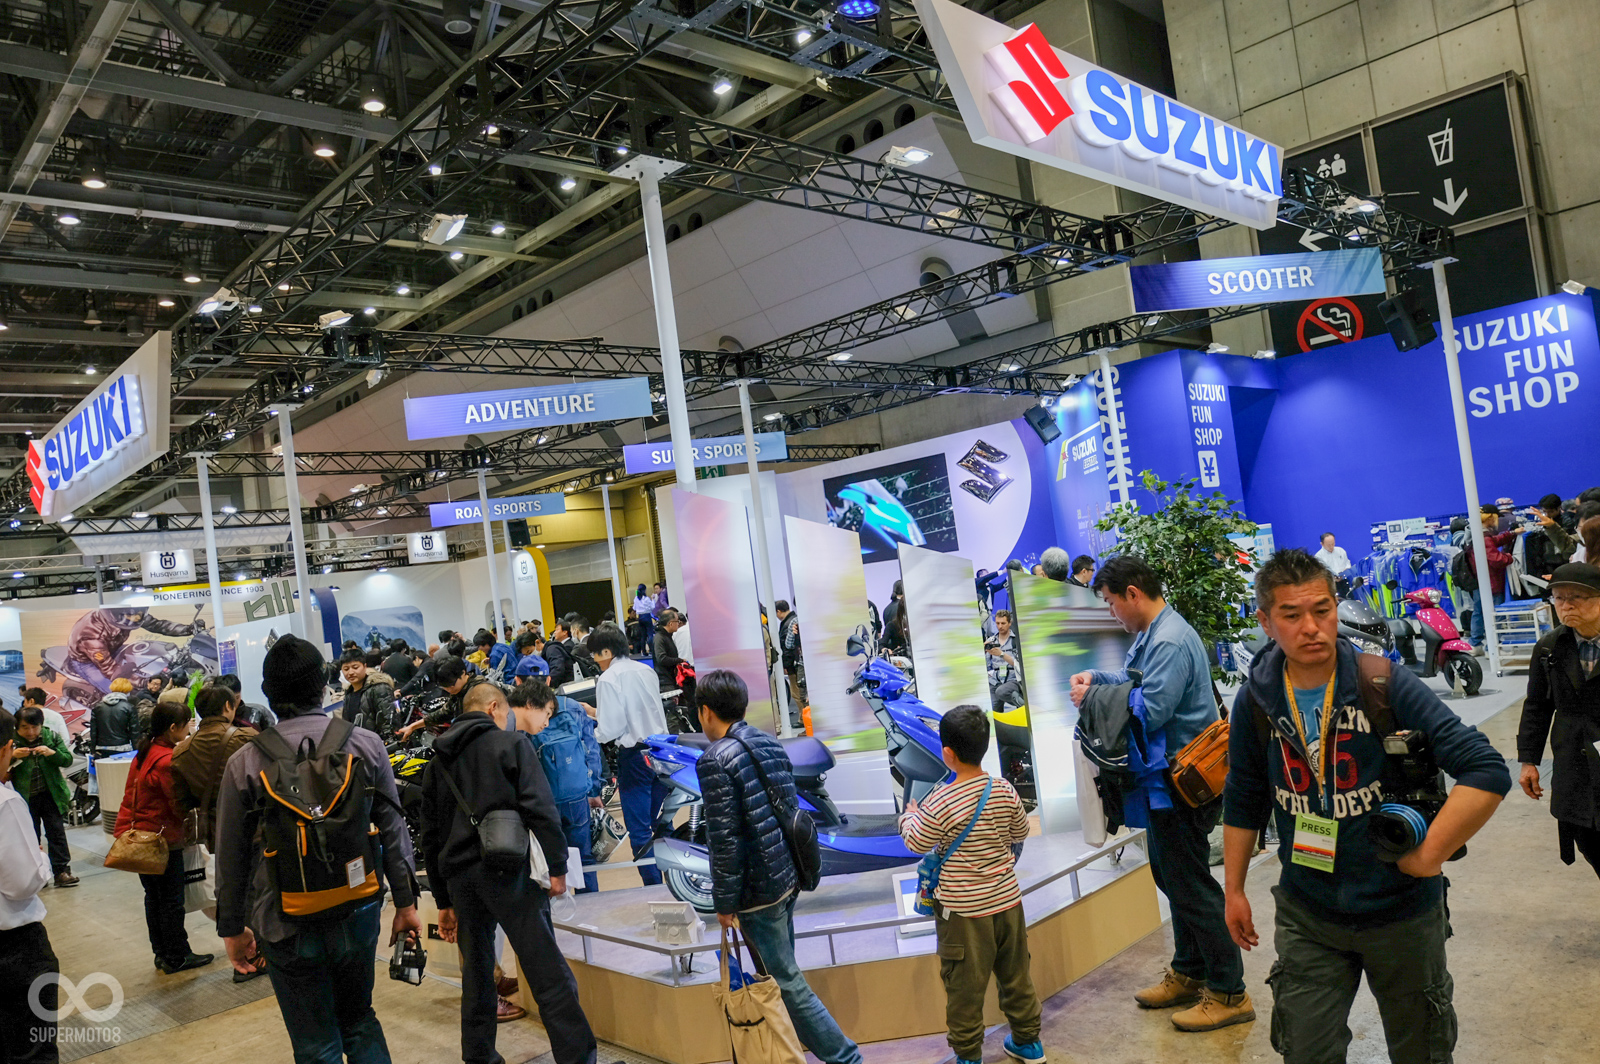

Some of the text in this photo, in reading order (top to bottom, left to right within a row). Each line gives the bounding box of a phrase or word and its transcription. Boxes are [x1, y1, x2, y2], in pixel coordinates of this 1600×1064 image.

[1086, 69, 1283, 199] SUZUKI
[1208, 266, 1314, 295] SCOOTER
[1504, 339, 1574, 378] FUN
[1188, 382, 1226, 402] SUZUKI
[1469, 371, 1579, 418] SHOP
[465, 393, 596, 424] ADVENTURE
[1191, 405, 1212, 423] FUN
[44, 375, 132, 491] SUZUKI
[1194, 427, 1222, 446] SHOP
[651, 447, 700, 465] SUR
[1072, 436, 1097, 462] SUZUKI
[455, 500, 541, 520] ROA SPORTS
[414, 550, 443, 558] Husqvarna
[150, 570, 189, 578] Husqvarna
[153, 585, 264, 601] PIONEERING INCE 1903
[1333, 780, 1383, 819] DEPT
[1301, 822, 1332, 836] PRESS
